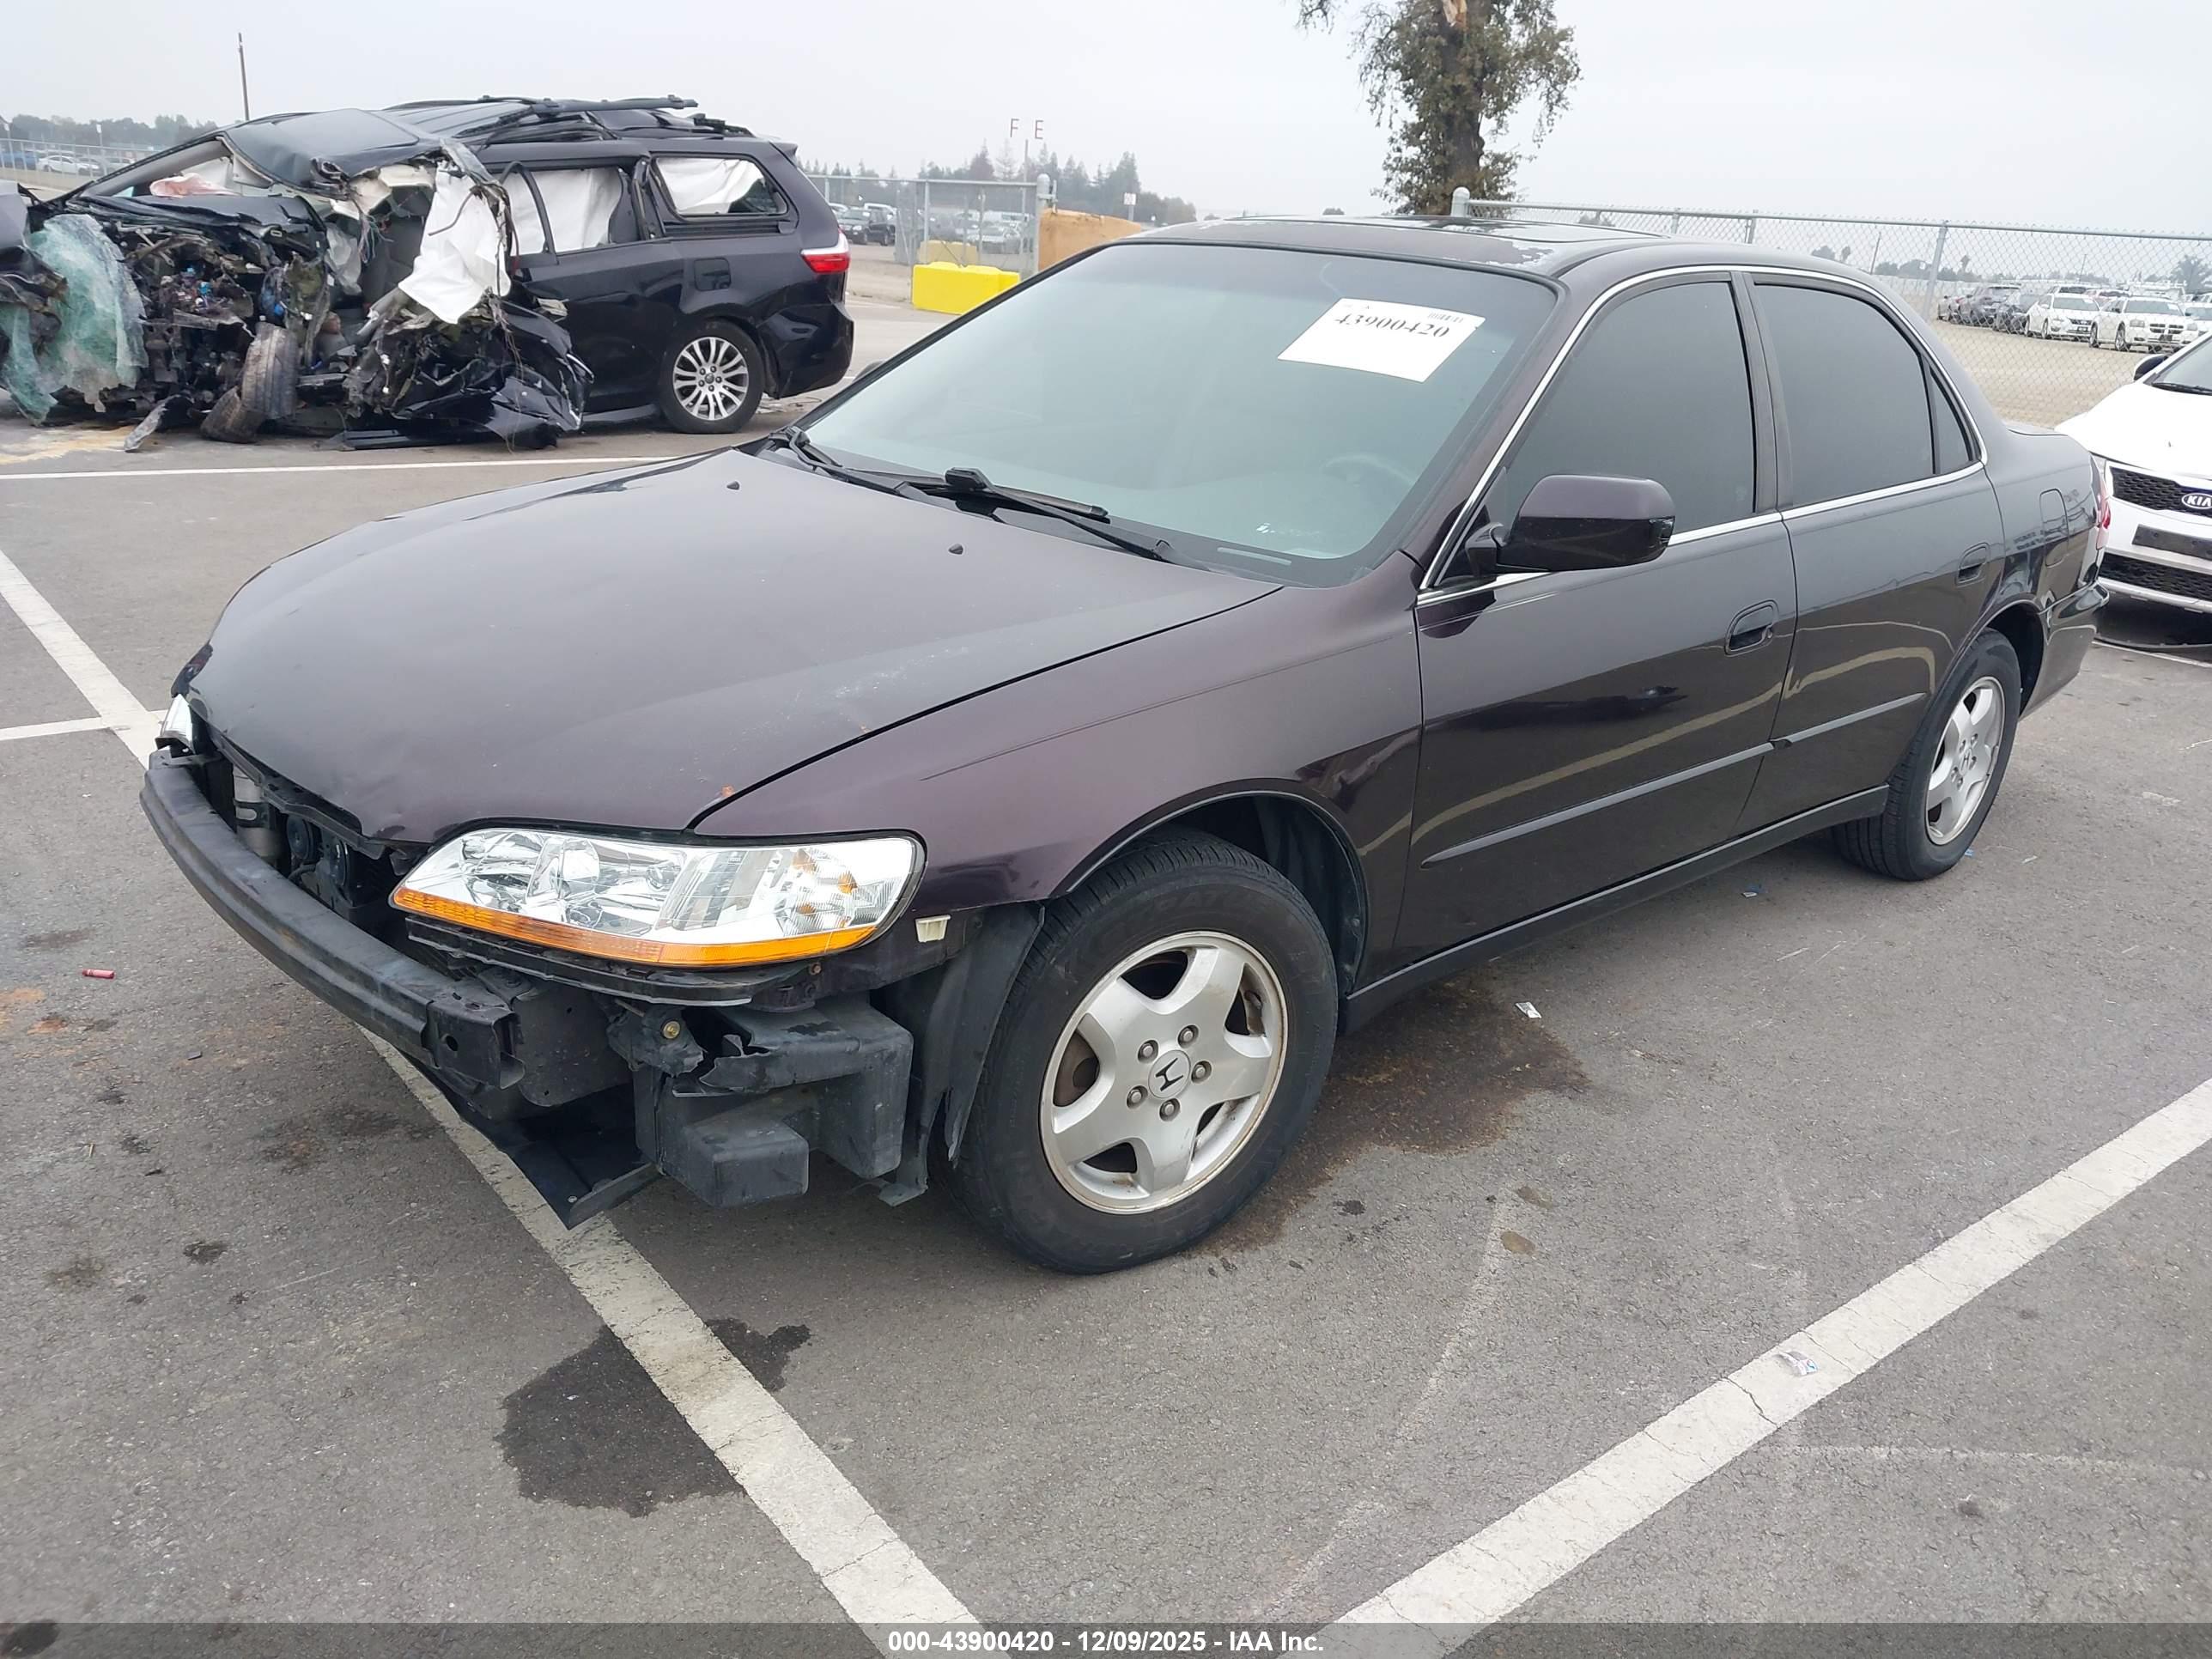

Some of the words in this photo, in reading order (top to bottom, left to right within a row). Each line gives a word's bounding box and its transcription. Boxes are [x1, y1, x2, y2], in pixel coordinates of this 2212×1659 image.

[1010, 118, 1020, 138] F
[1035, 119, 1044, 140] E
[1334, 313, 1450, 337] 43900420
[2186, 495, 2212, 507] KIA
